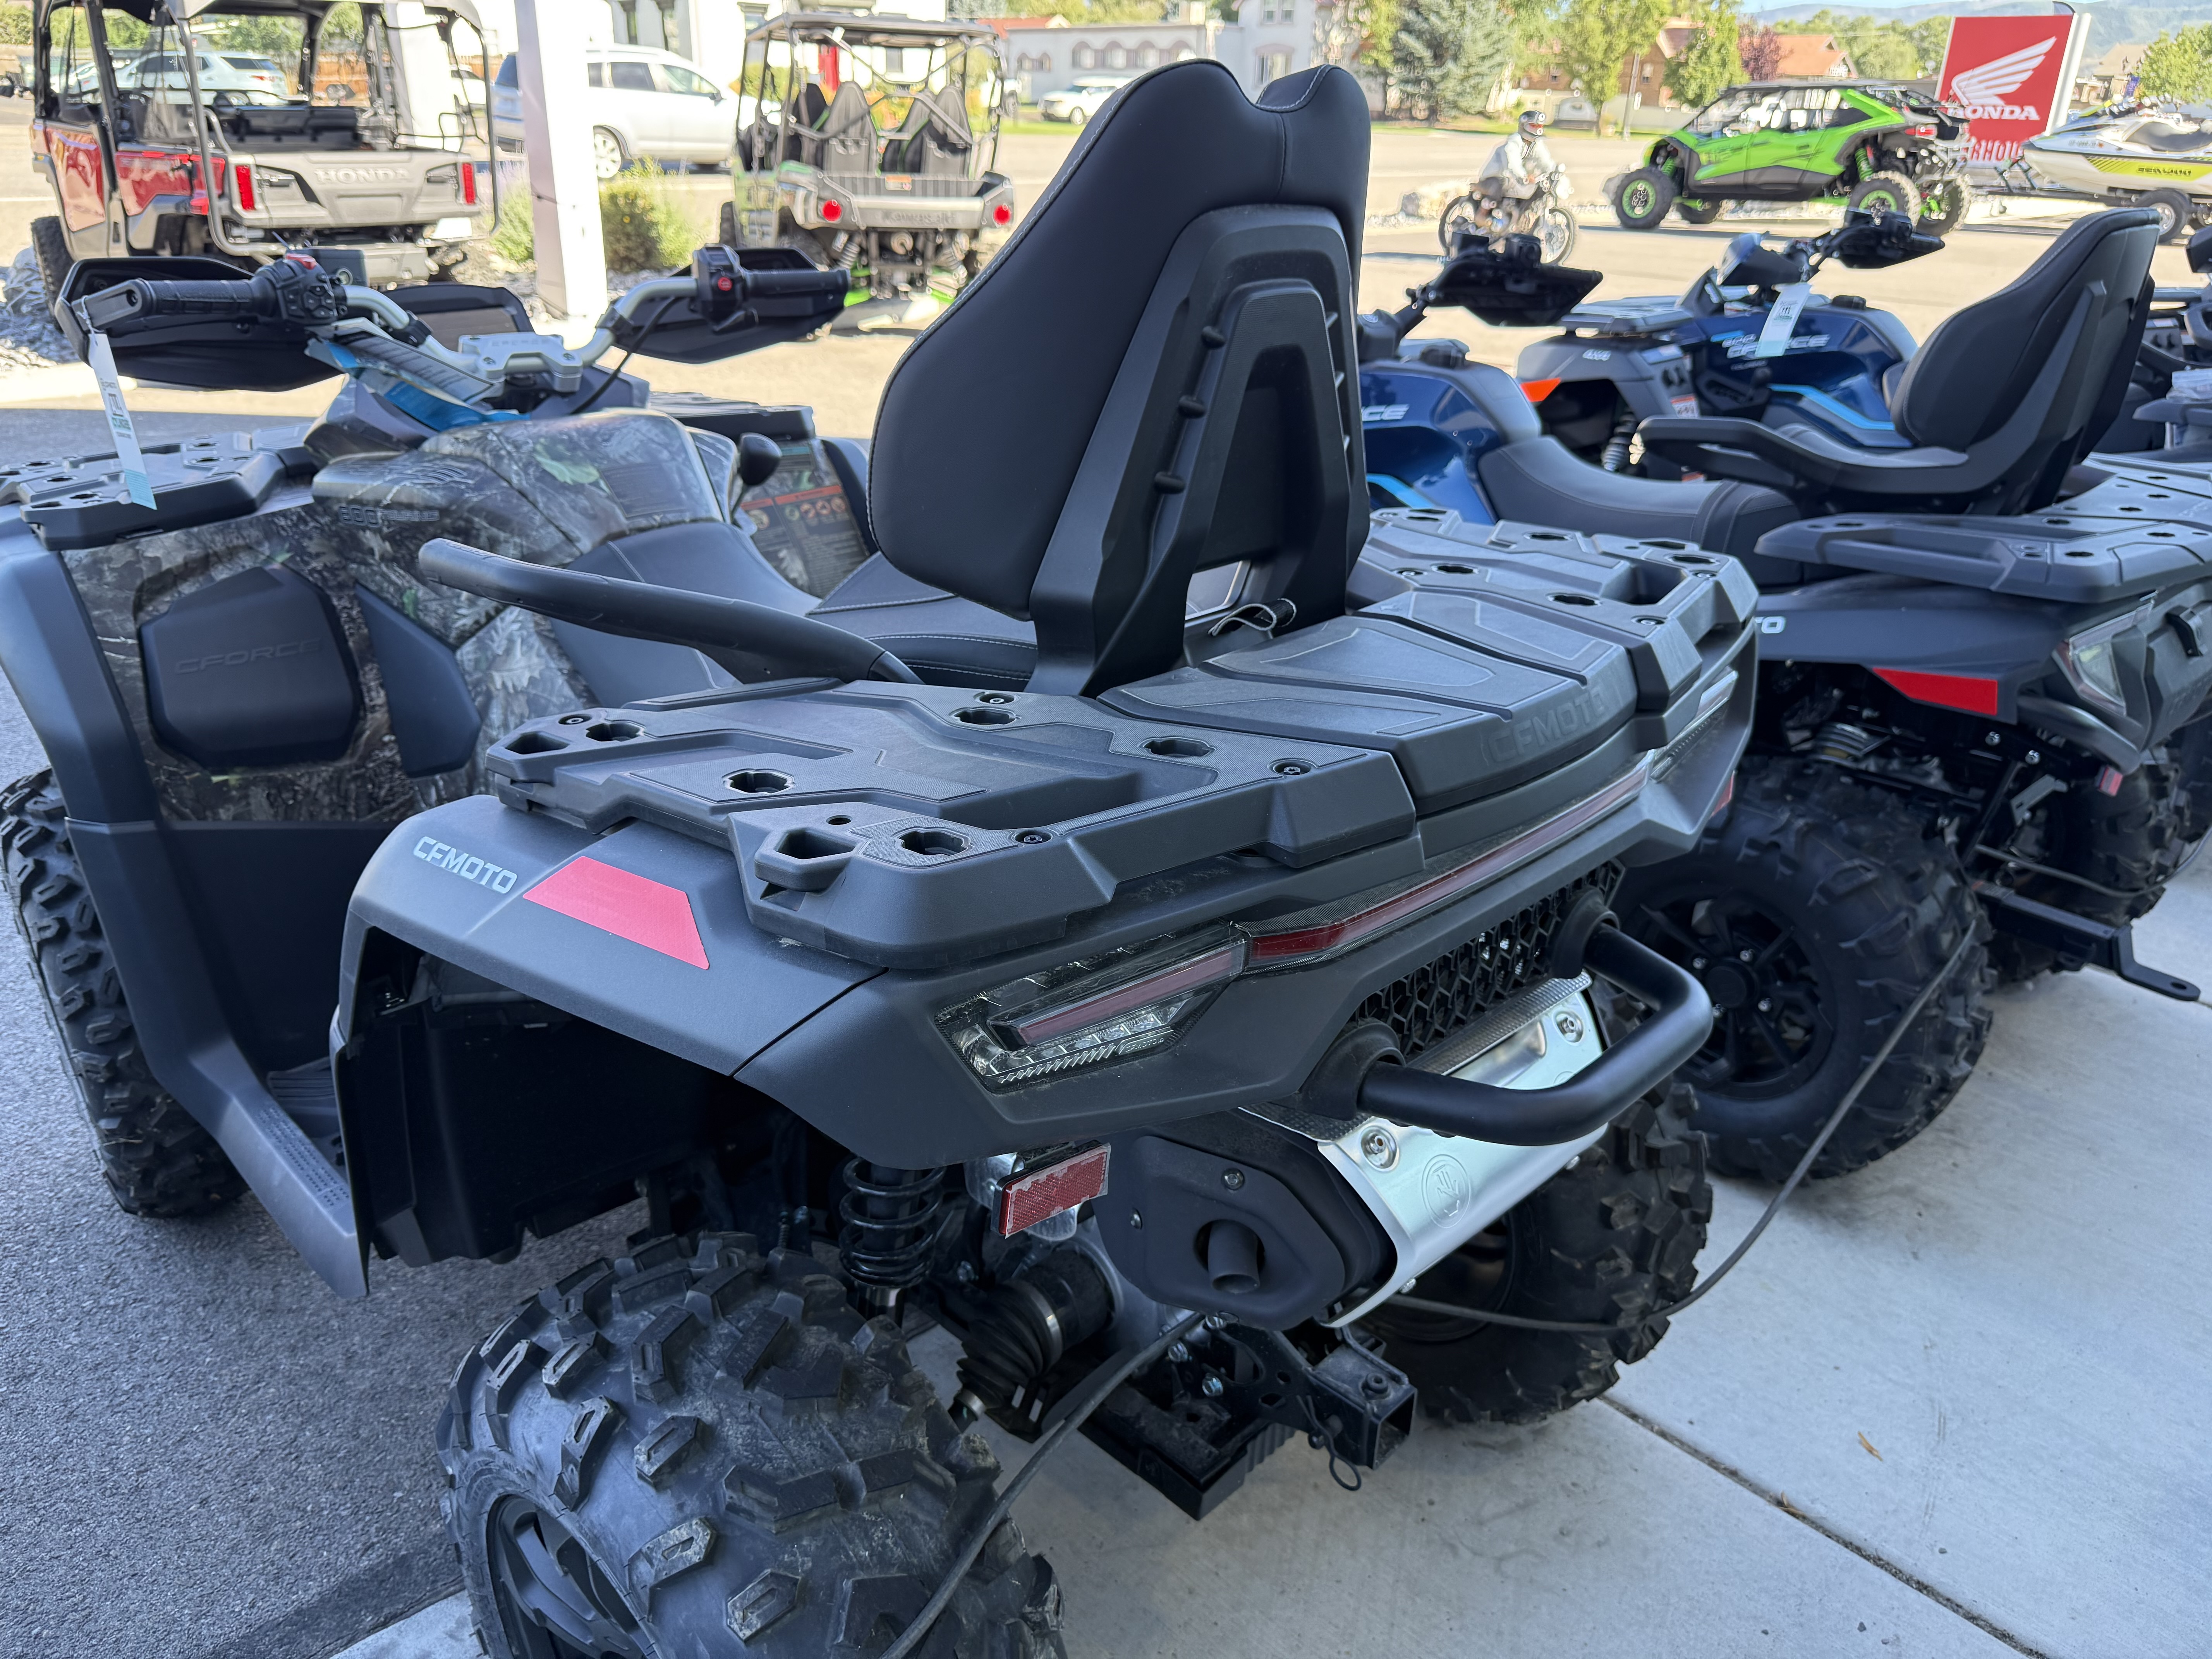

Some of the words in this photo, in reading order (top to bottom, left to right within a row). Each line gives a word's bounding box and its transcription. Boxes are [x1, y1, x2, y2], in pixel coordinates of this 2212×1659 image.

[314, 168, 410, 184] HONDA
[1727, 334, 1832, 359] CFCE
[1361, 404, 1410, 422] CE
[175, 638, 321, 675] CFORCE
[1487, 687, 1606, 763] CFMOTO
[413, 836, 517, 894] CFMOTO
